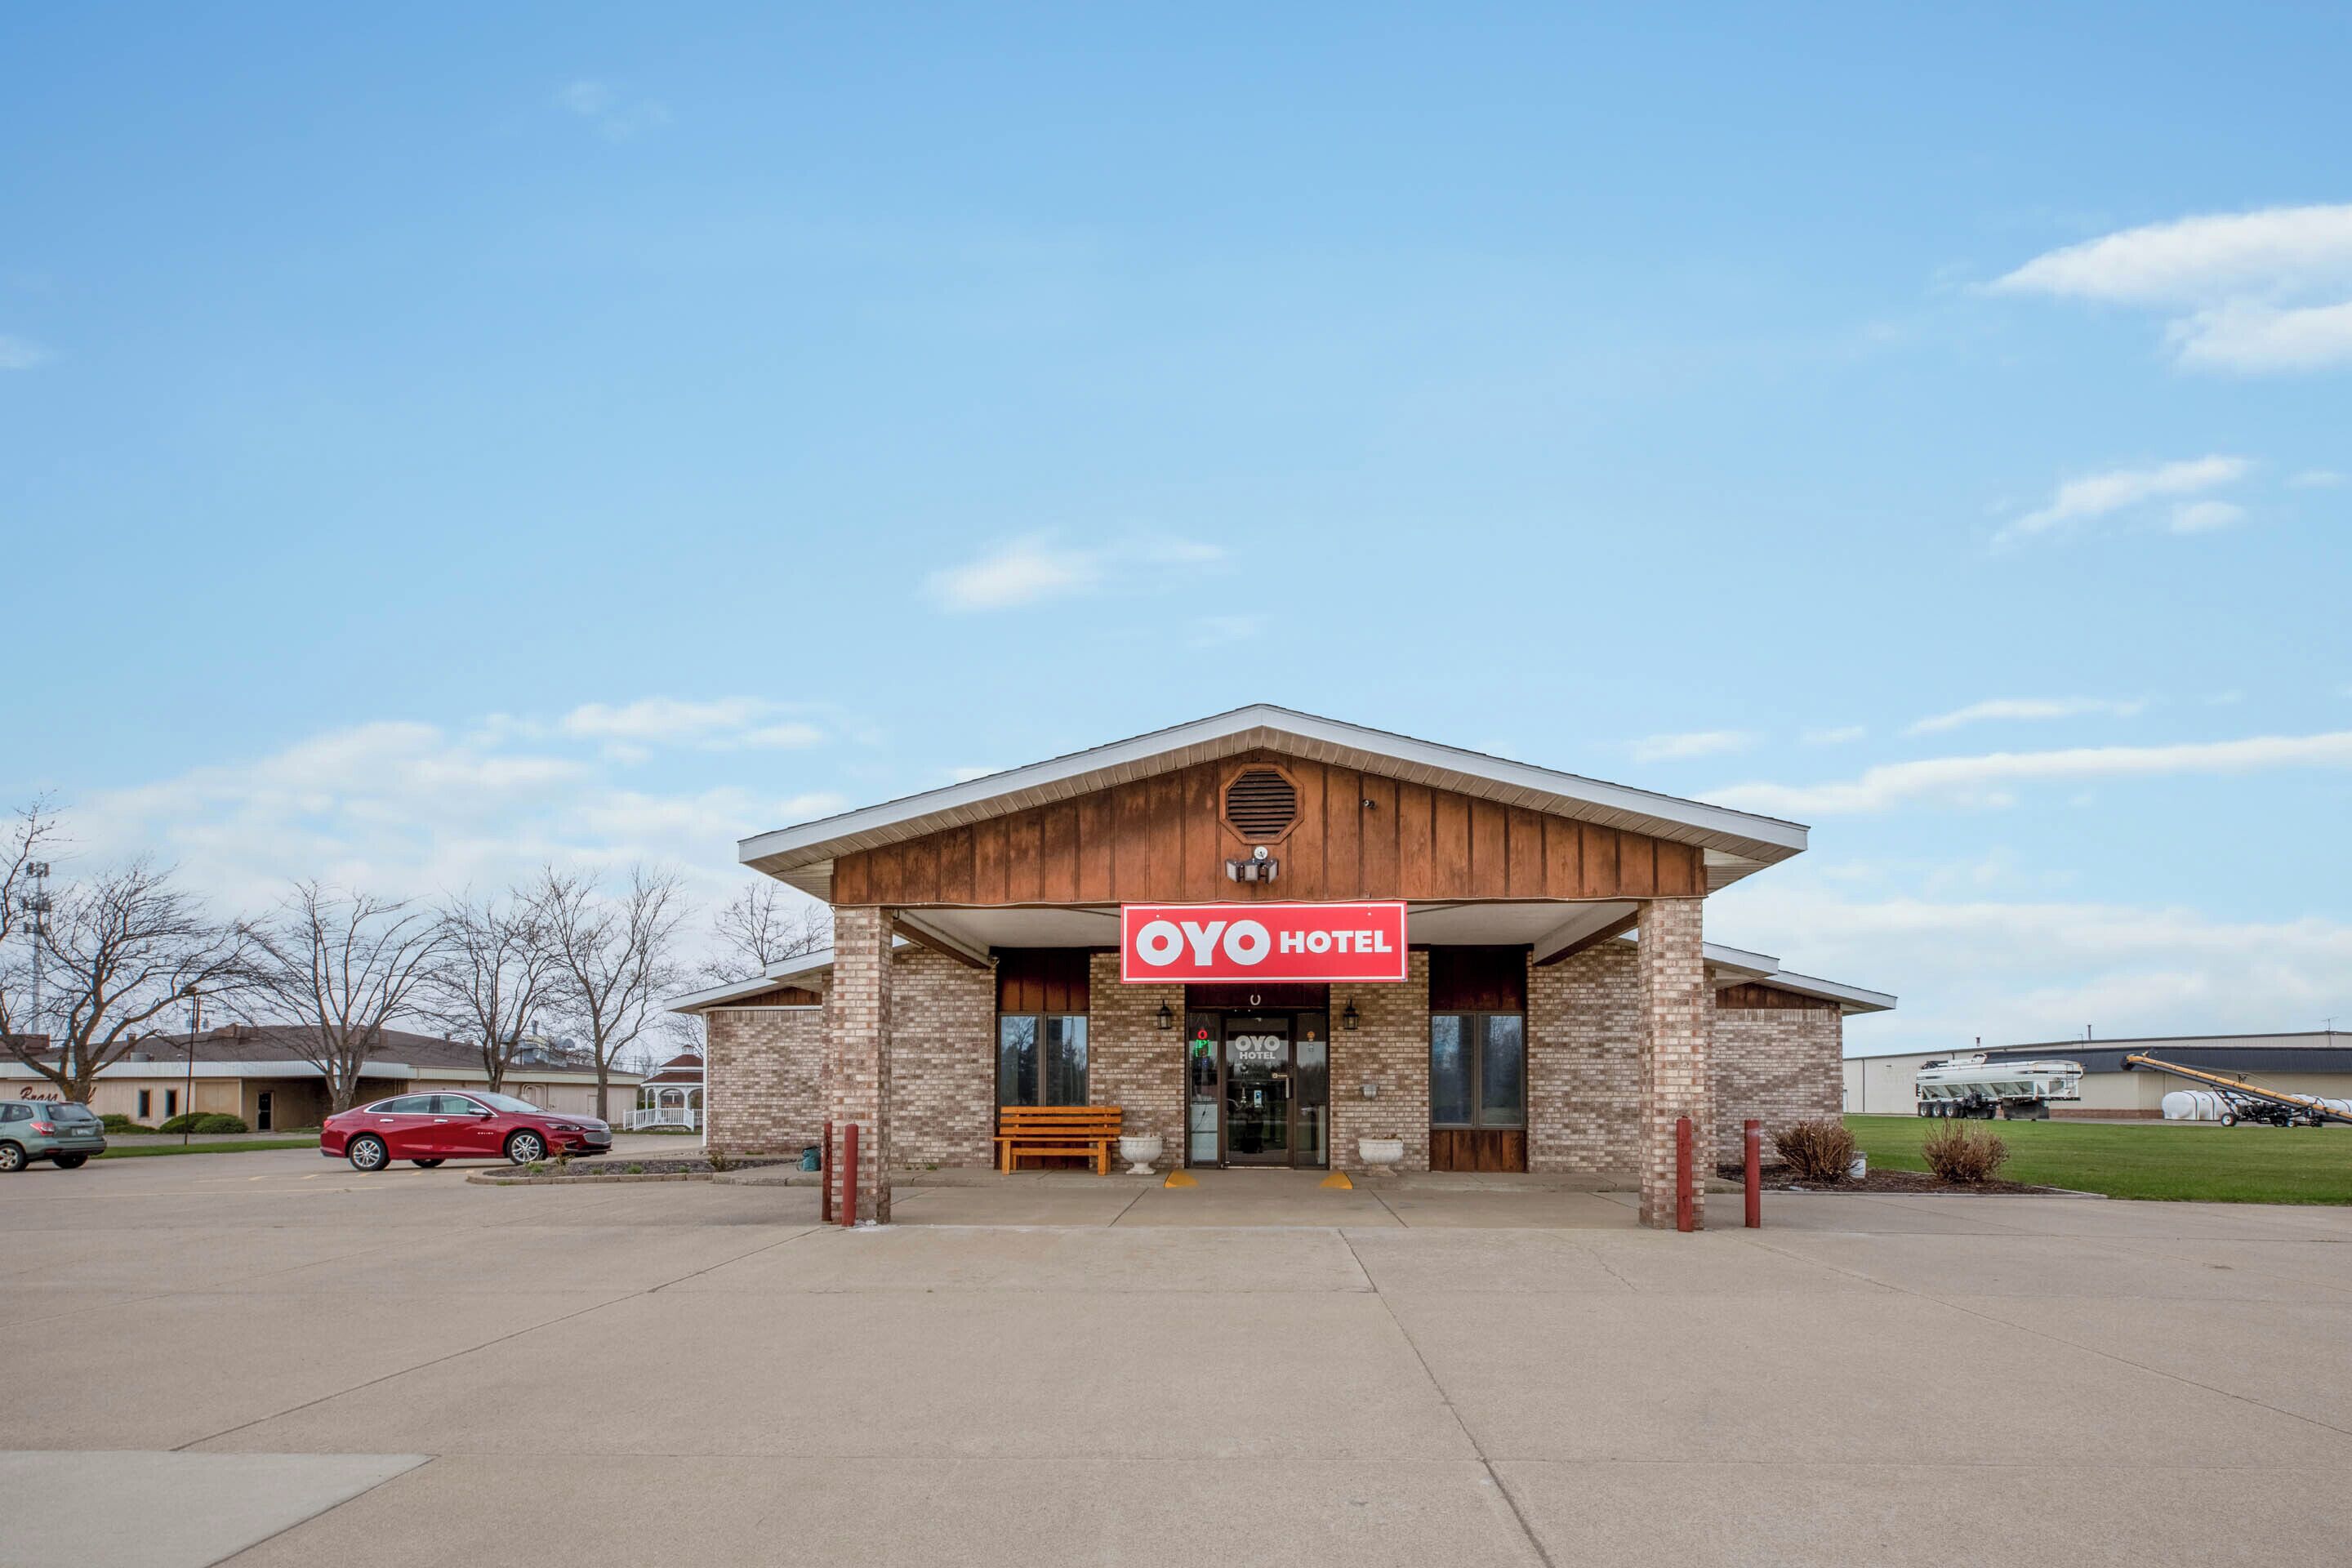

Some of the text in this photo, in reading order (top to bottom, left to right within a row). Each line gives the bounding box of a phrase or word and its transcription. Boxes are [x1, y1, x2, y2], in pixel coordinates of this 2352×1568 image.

[1136, 920, 1392, 966] OYO HOTEL
[1235, 1035, 1281, 1052] OYO
[1239, 1051, 1276, 1060] HOTEL
